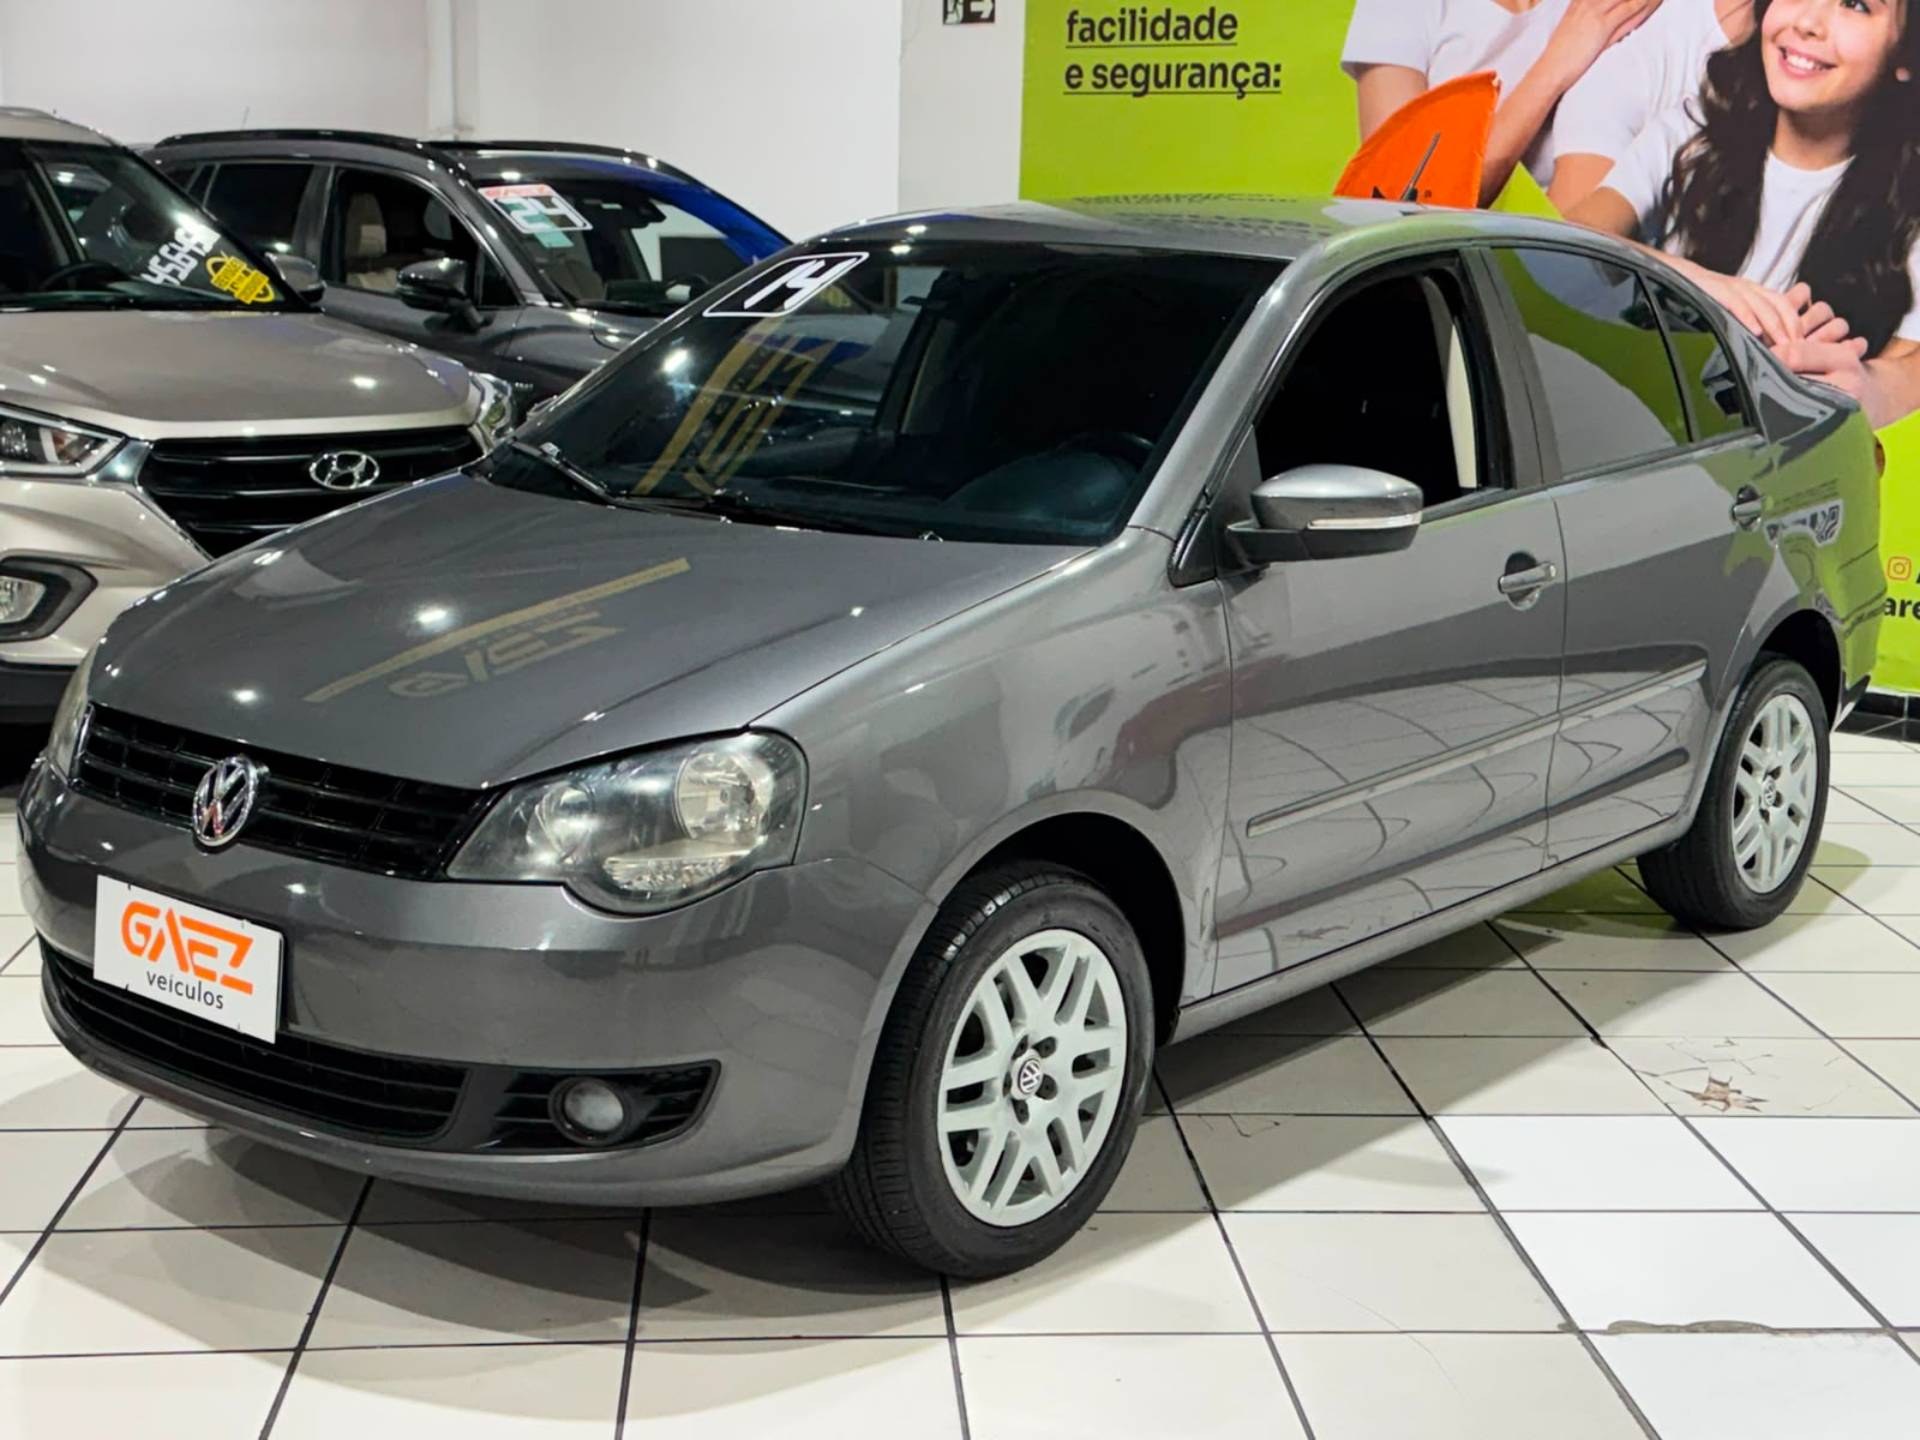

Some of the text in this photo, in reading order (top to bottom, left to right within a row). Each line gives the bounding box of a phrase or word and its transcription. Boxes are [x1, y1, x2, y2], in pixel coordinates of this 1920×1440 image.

[1066, 6, 1238, 43] facilidade
[1064, 61, 1282, 100] e segurança:
[492, 195, 586, 231] 24
[743, 257, 858, 311] 14
